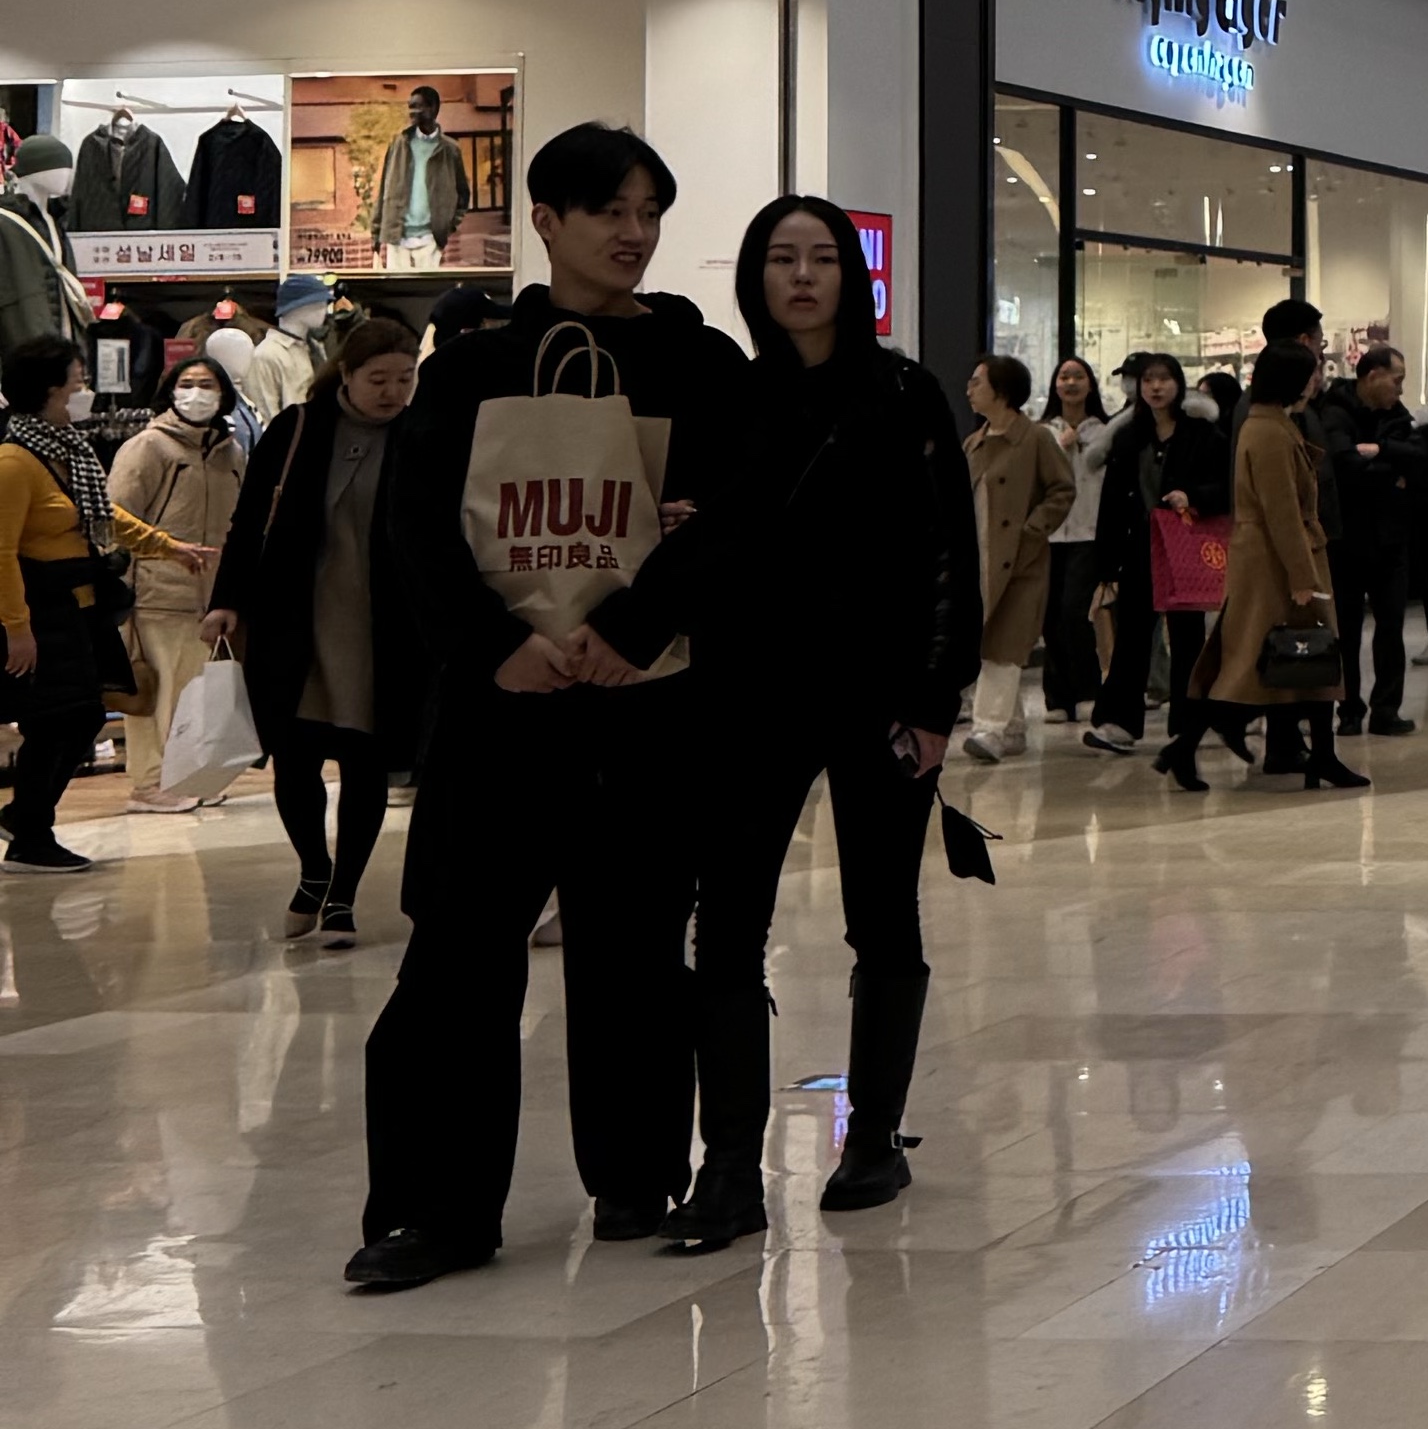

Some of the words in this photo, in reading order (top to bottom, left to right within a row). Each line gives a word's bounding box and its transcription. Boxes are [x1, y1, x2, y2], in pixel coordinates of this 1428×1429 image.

[857, 227, 884, 271] NI
[496, 477, 633, 540] MUJI
[508, 540, 621, 573] 無印良品
